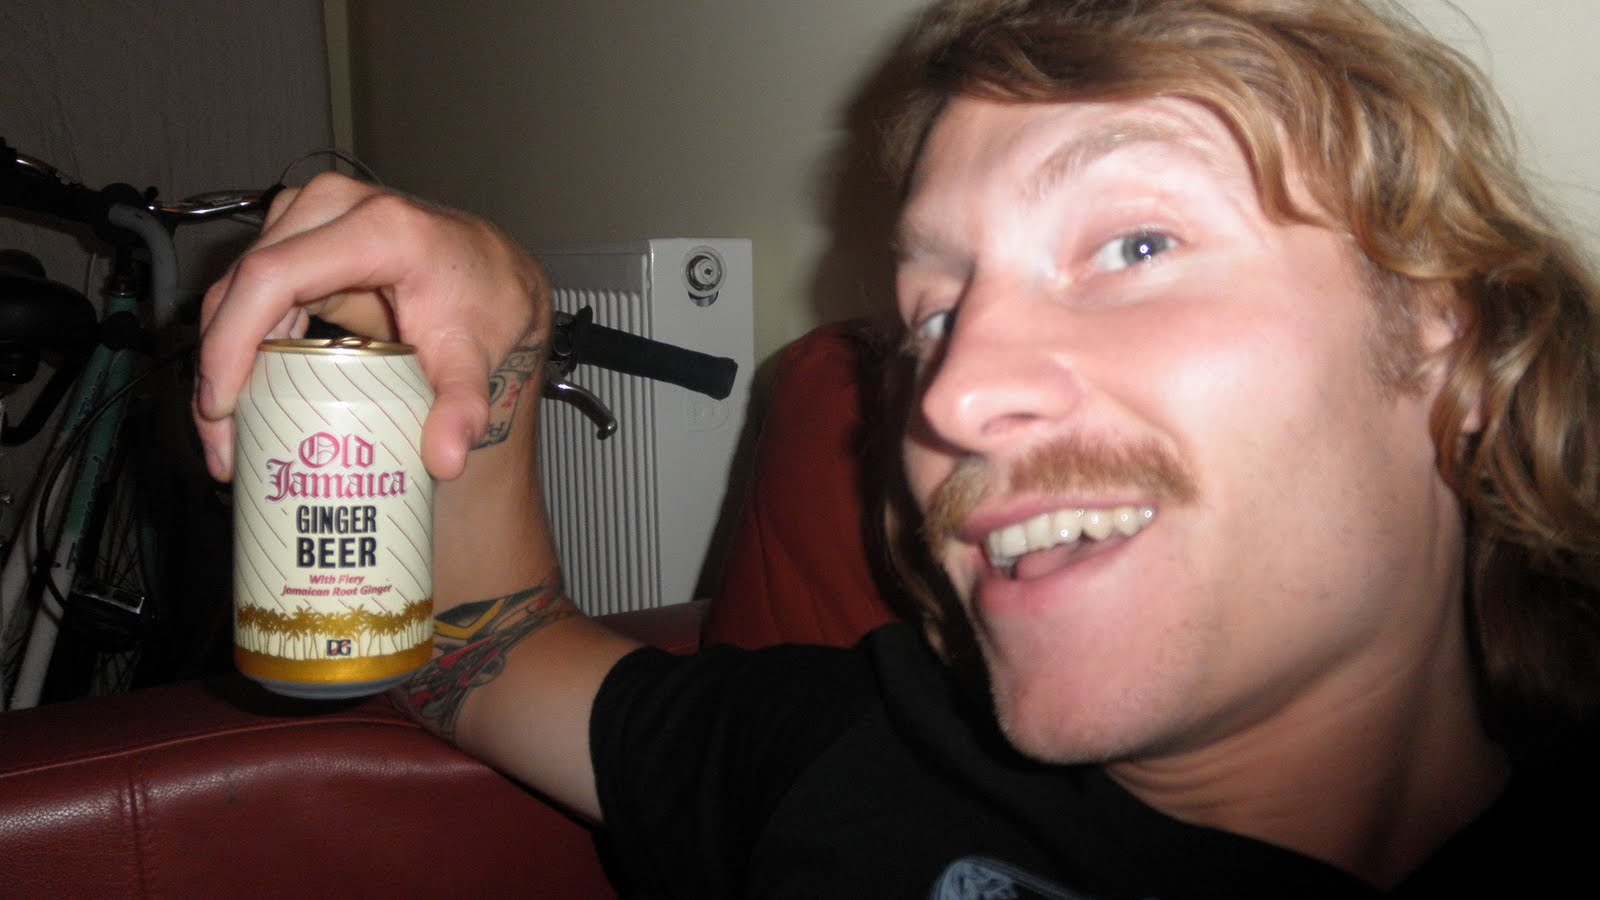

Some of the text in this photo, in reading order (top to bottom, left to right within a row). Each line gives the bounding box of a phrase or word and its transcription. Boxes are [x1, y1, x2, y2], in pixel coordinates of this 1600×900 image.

[298, 431, 375, 469] Old
[264, 458, 406, 503] Jamaica
[295, 504, 377, 535] GINGER
[296, 536, 377, 569] BEER
[281, 583, 392, 597] Jamaican Root Ginger
[309, 574, 365, 586] With Fiery
